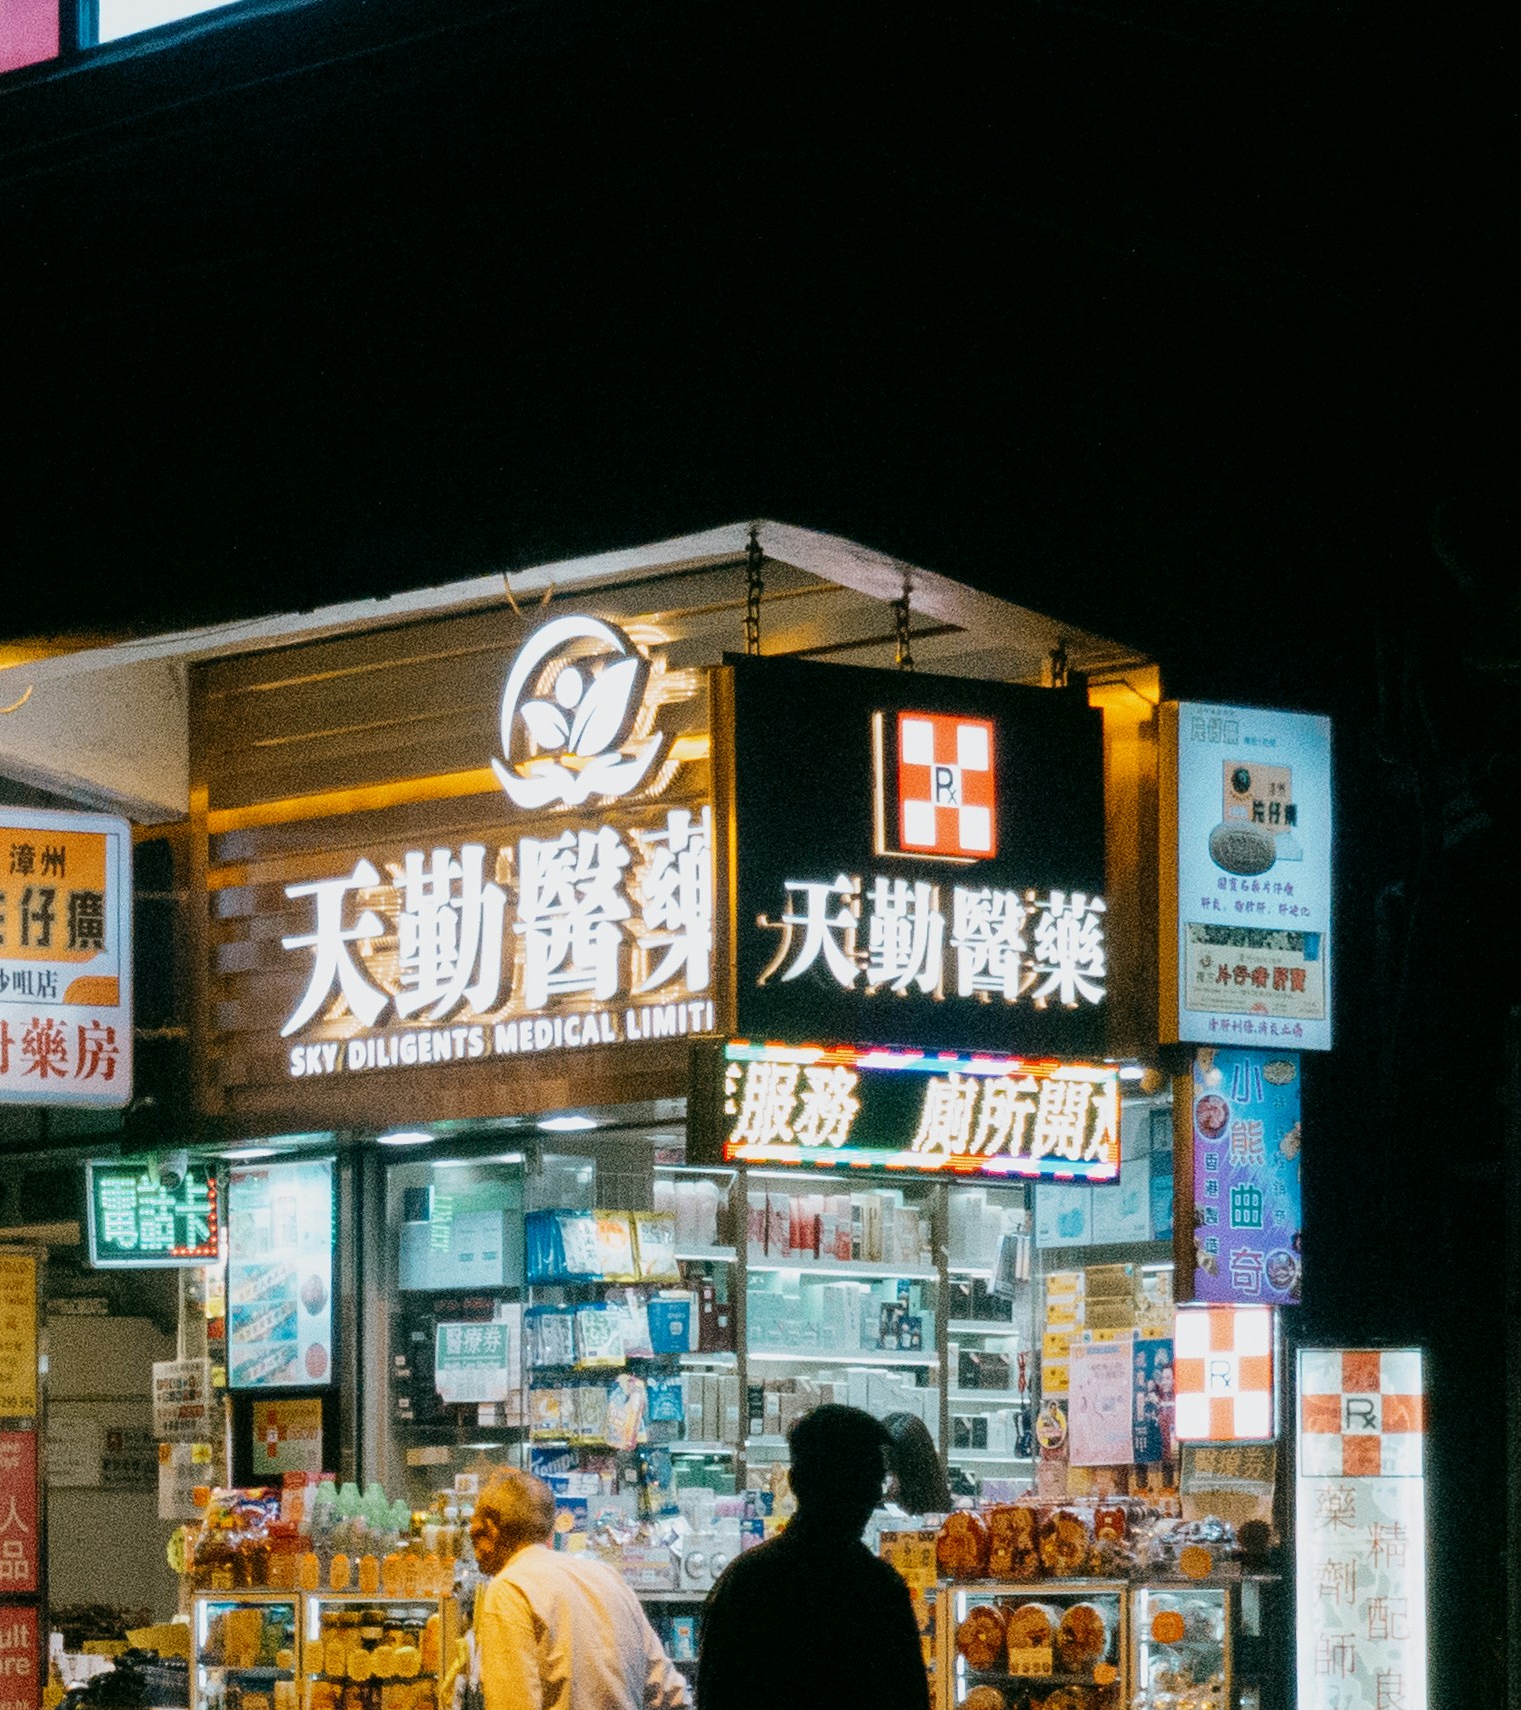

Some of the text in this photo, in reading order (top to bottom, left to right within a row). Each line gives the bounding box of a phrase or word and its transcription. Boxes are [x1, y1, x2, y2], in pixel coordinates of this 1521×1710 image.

[9, 843, 67, 879] 漳州
[780, 875, 1107, 1006] 天勤醫藥
[290, 1001, 713, 1076] SKY DILIGENTS MEDICAL LIMIT
[1229, 1057, 1264, 1296] 小熊曲奇
